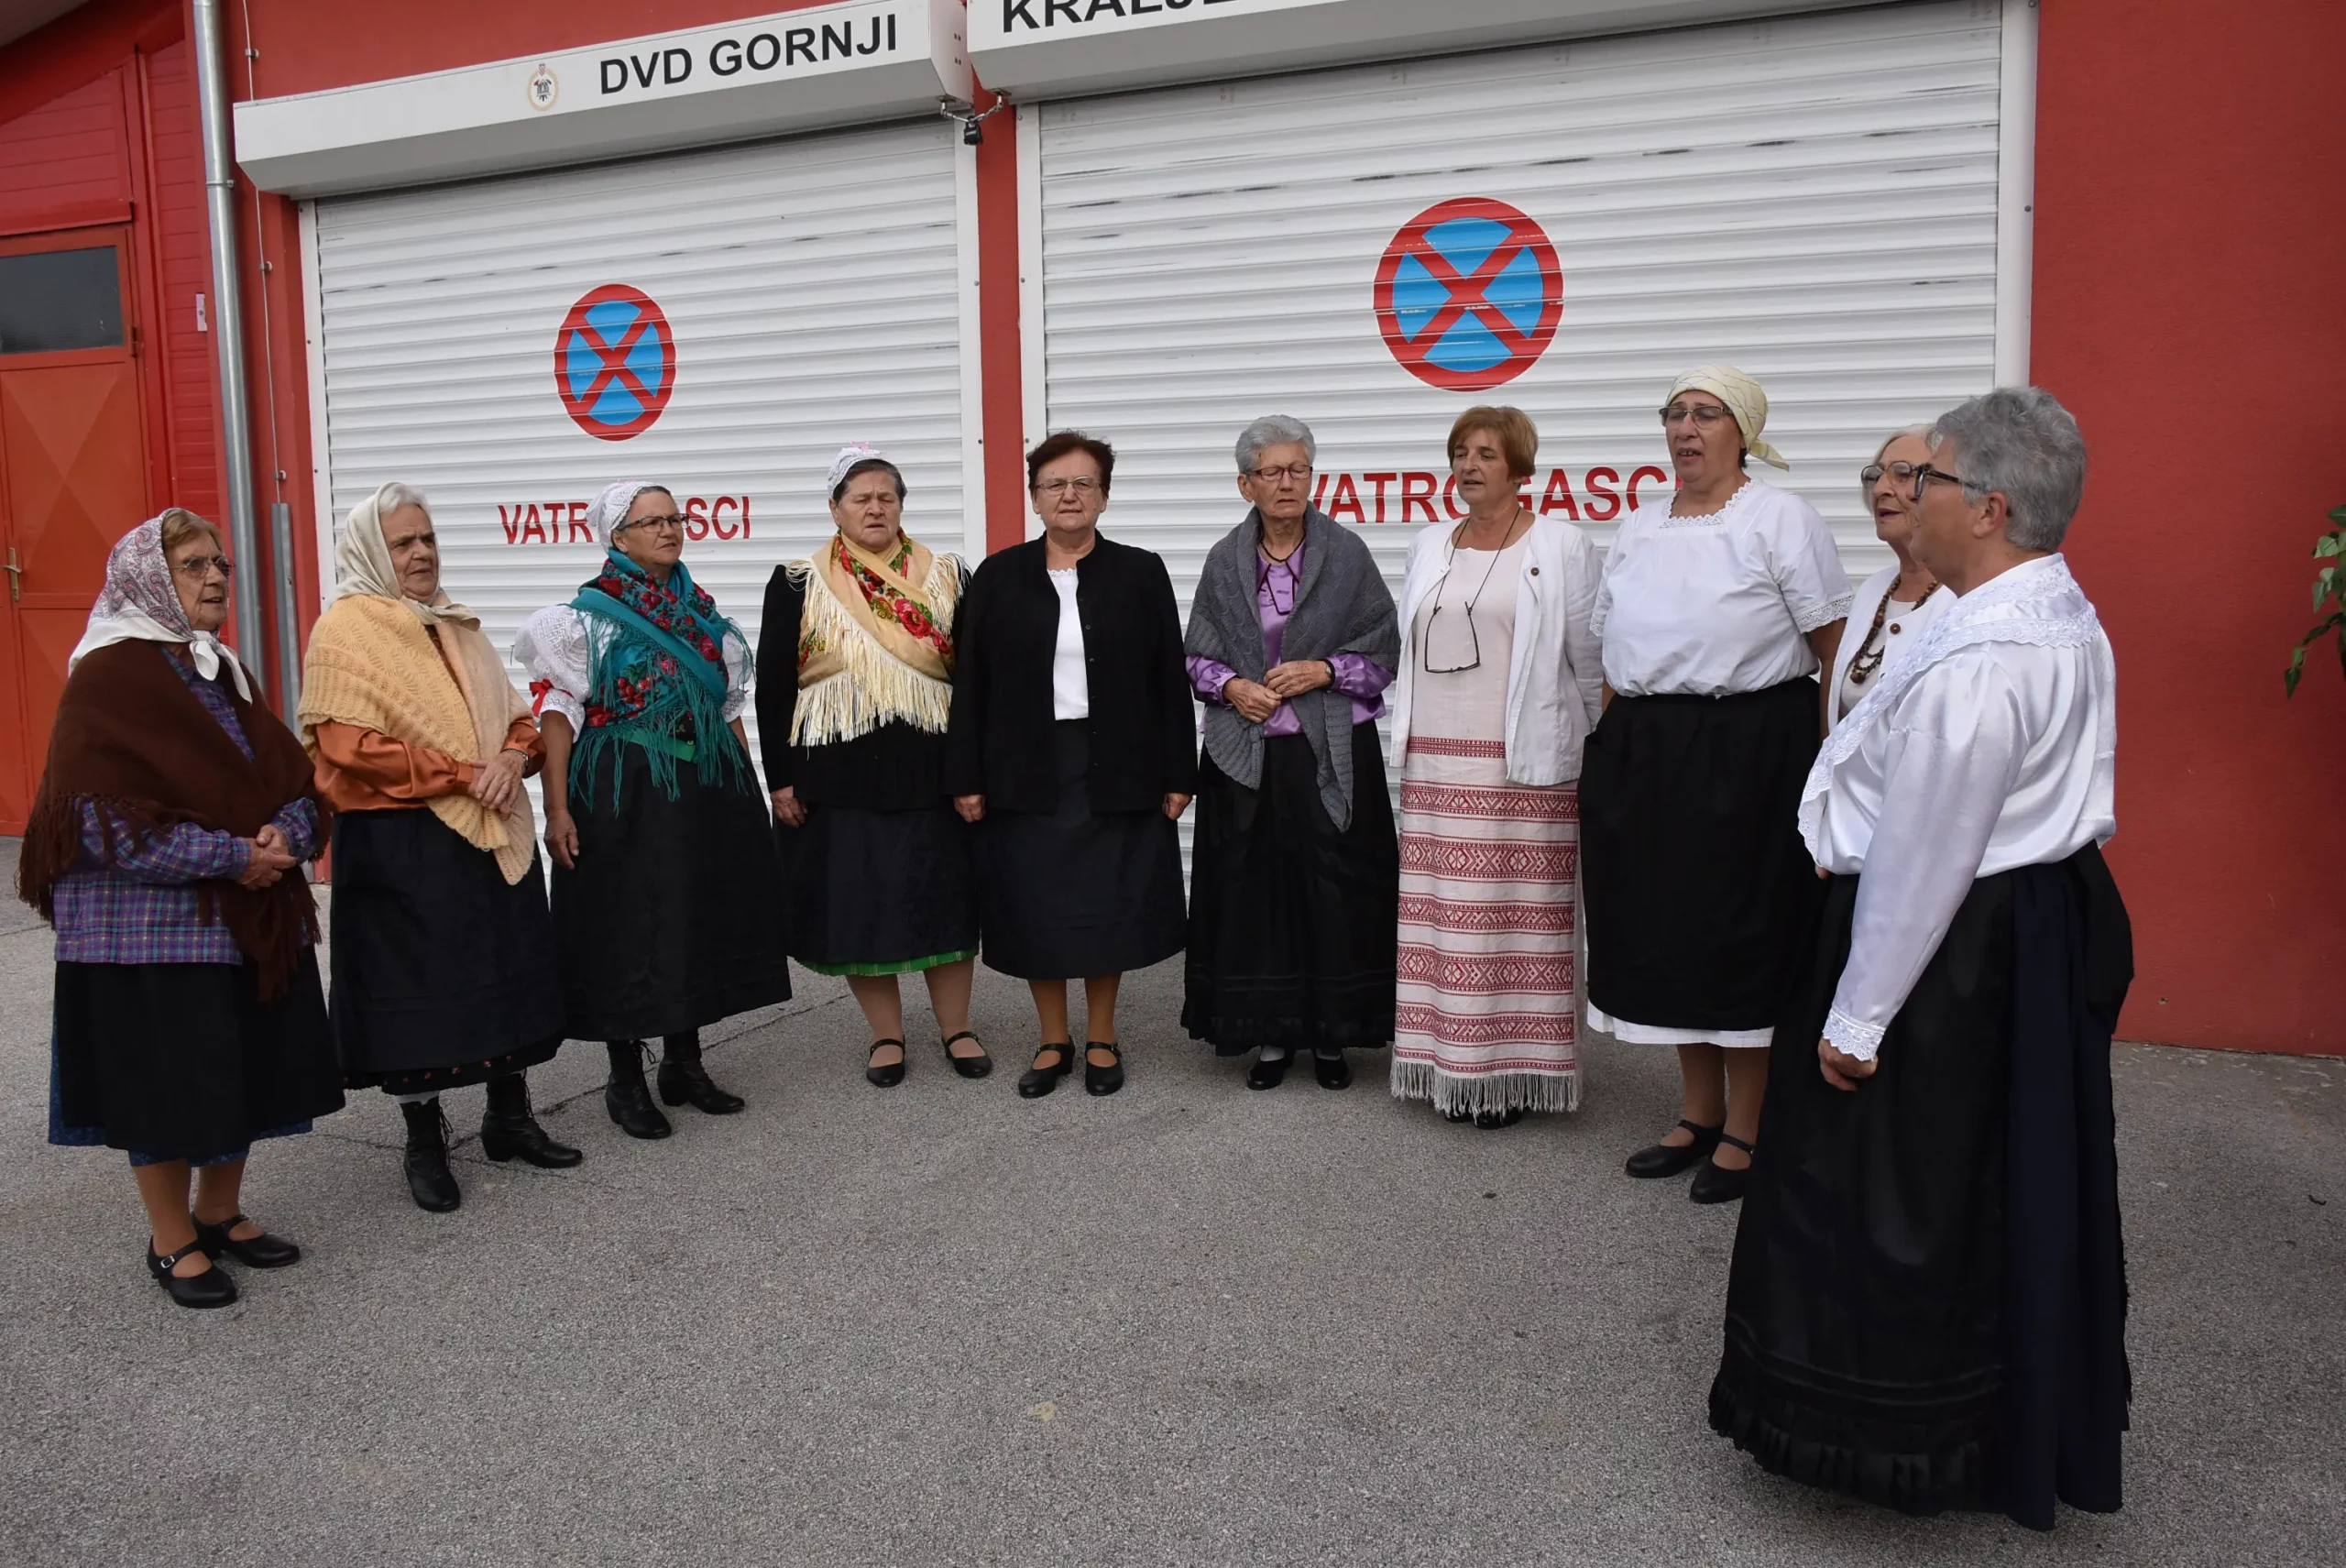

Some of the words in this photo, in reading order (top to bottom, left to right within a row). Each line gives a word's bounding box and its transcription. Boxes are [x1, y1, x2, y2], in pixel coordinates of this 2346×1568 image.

[599, 48, 693, 95] DVD
[708, 13, 897, 77] GORNJI
[498, 496, 751, 544] VATRSCI
[1313, 465, 1683, 523] ATRASC
